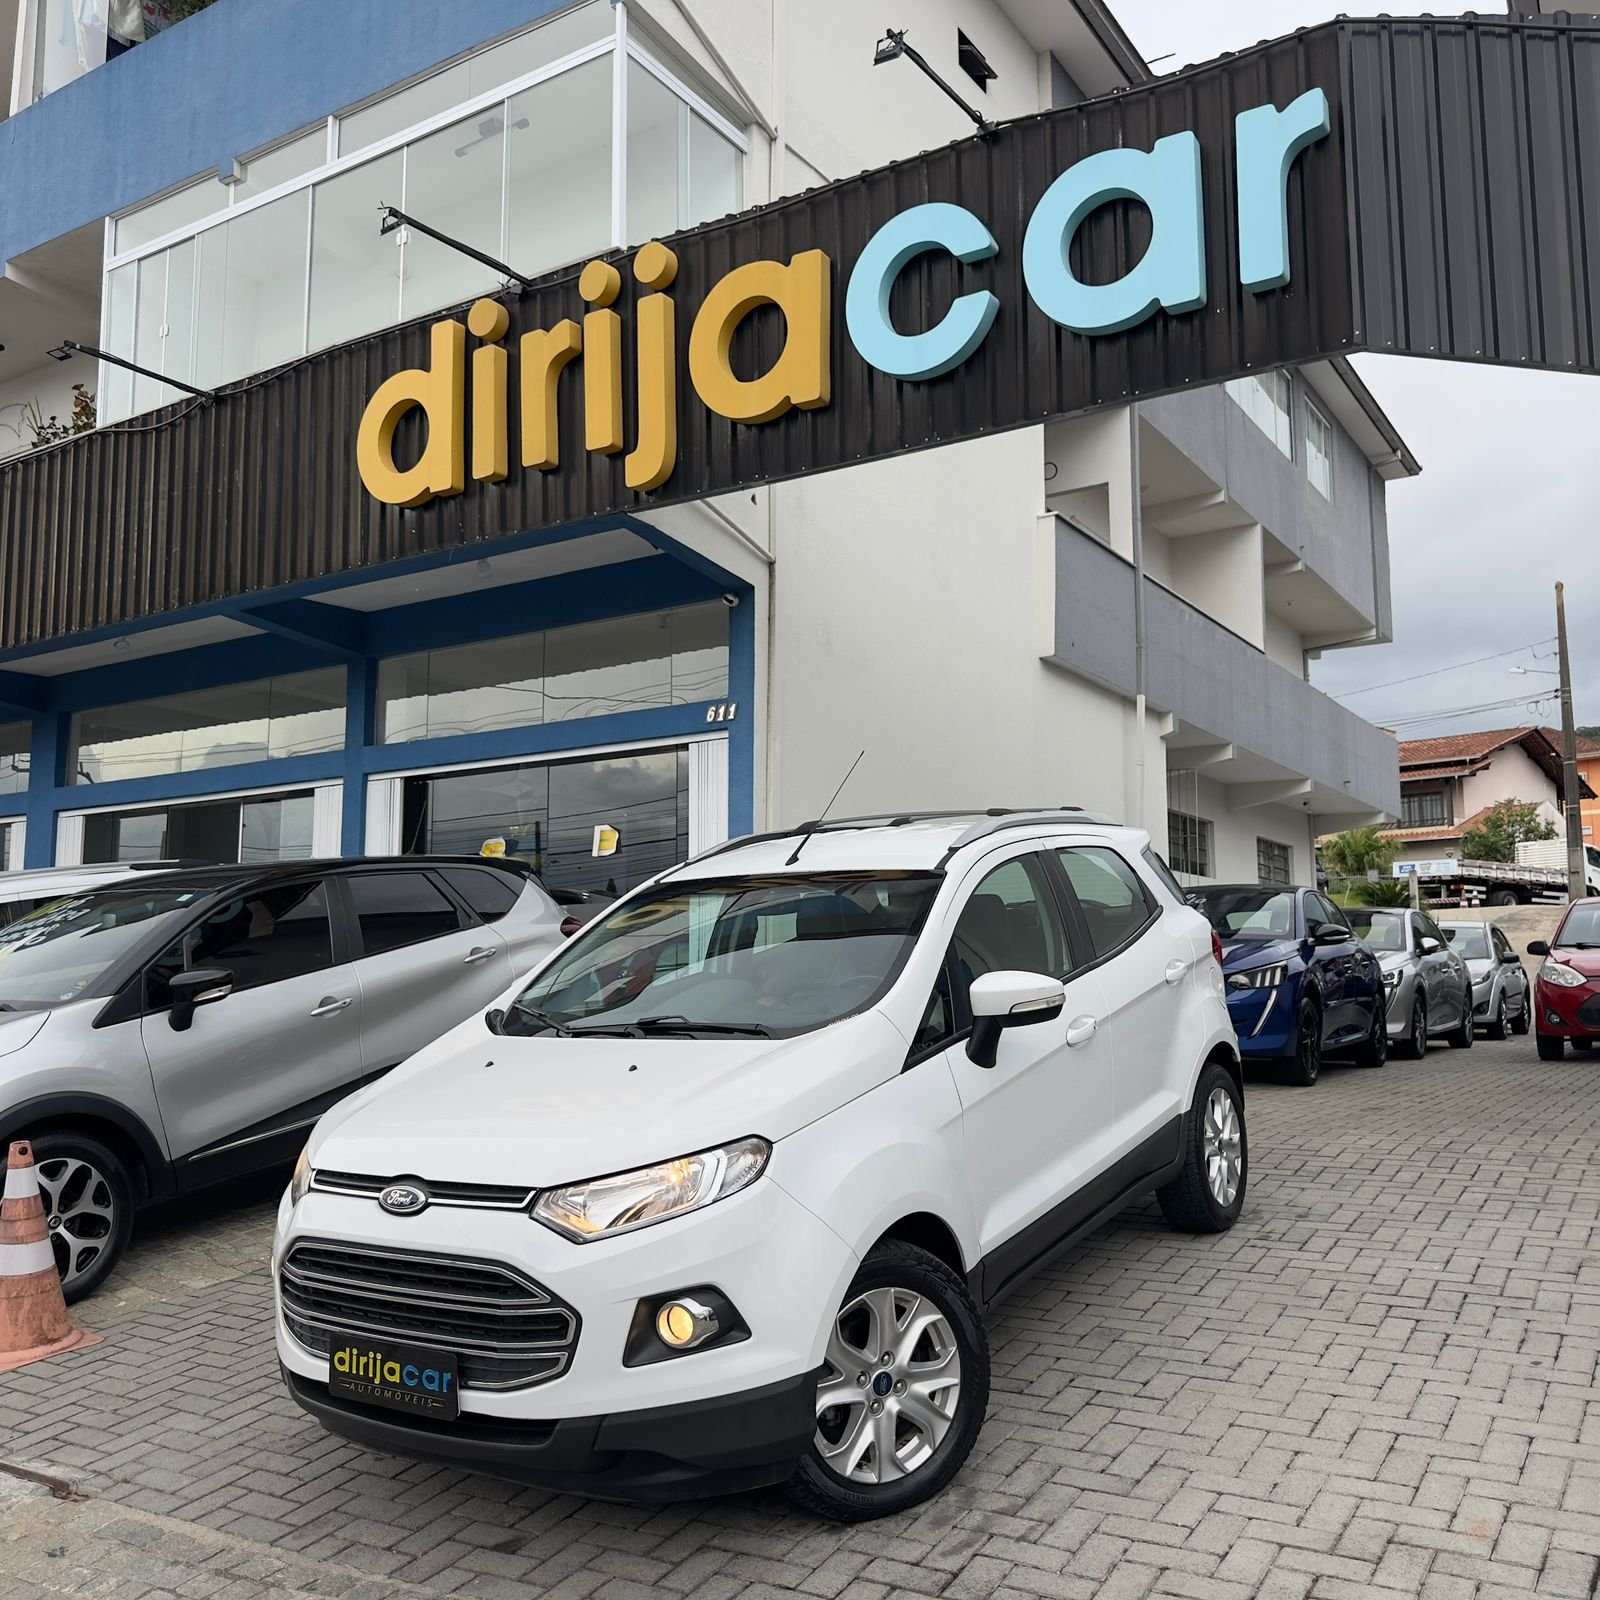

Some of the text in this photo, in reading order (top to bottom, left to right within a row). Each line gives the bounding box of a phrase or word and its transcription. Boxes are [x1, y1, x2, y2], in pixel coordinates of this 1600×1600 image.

[357, 88, 1330, 508] dirijacar
[706, 703, 736, 722] 611
[387, 1190, 413, 1205] Ford
[333, 1347, 452, 1393] dirijacar
